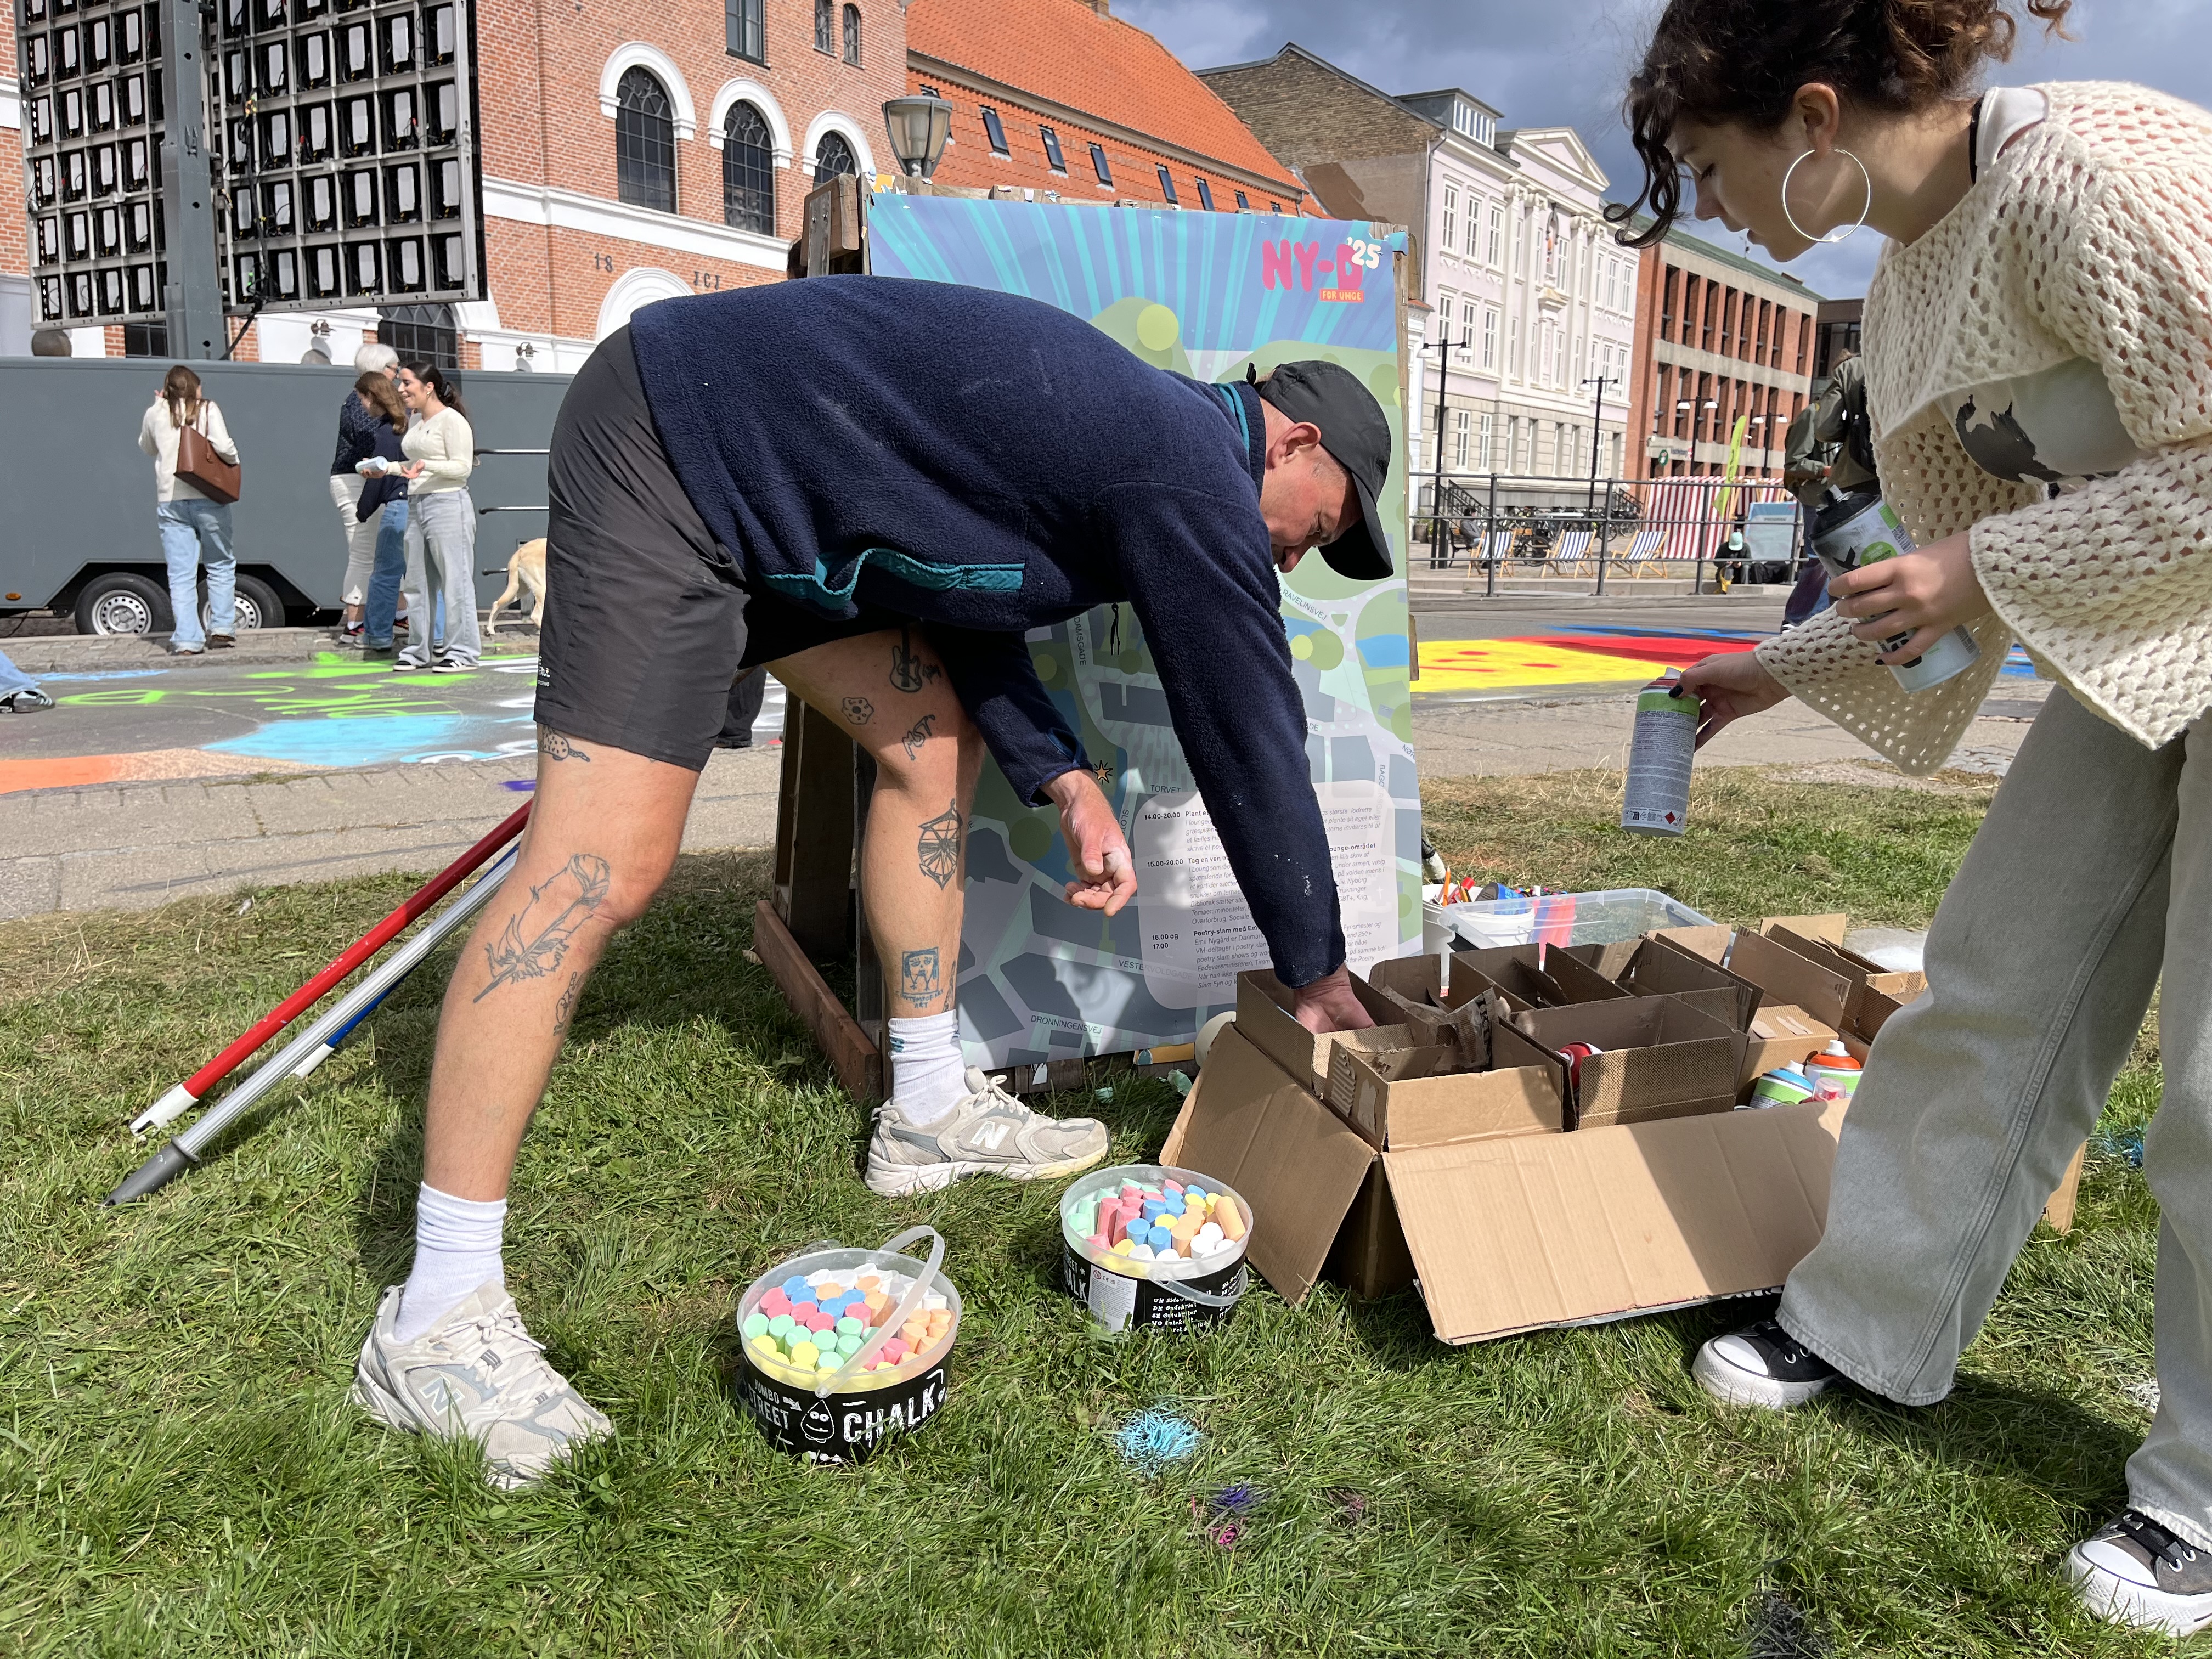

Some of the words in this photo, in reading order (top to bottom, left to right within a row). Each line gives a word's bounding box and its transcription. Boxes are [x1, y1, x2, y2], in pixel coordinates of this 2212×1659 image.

[1322, 290, 1336, 300] FOR
[1339, 290, 1362, 301] UNGE
[1283, 589, 1327, 620] RAVELINSVEJ
[1074, 617, 1087, 666] DAMSGADE
[1402, 744, 1415, 759] NØR
[1150, 785, 1181, 793] TORVET
[1186, 828, 1217, 836] græsplæn
[1329, 843, 1376, 852] ounge-området
[1147, 859, 1183, 867] 15.00-20.00
[1192, 864, 1232, 873] Loungeområd
[1189, 873, 1222, 882] spændende
[1190, 899, 1215, 907] Bibliotek
[1343, 922, 1373, 931] Fynsmester
[1193, 928, 1232, 936] Poetry-slam
[1208, 935, 1229, 945] Nygård
[1238, 932, 1267, 941] Danmark
[1195, 945, 1232, 954] VM-deltager
[1235, 943, 1254, 951] poetry
[1197, 955, 1216, 964] poetry
[1118, 959, 1193, 980] VESTERVOLDGADE
[1198, 961, 1254, 971] Fødevareministeren,
[1221, 970, 1232, 979] ikke
[1212, 980, 1223, 988] Fyn
[1031, 1015, 1102, 1034] DRONNINGENSVEJ
[754, 1378, 780, 1404] JUMBO
[748, 1383, 789, 1430] STREET
[843, 1383, 935, 1444] CHALK
